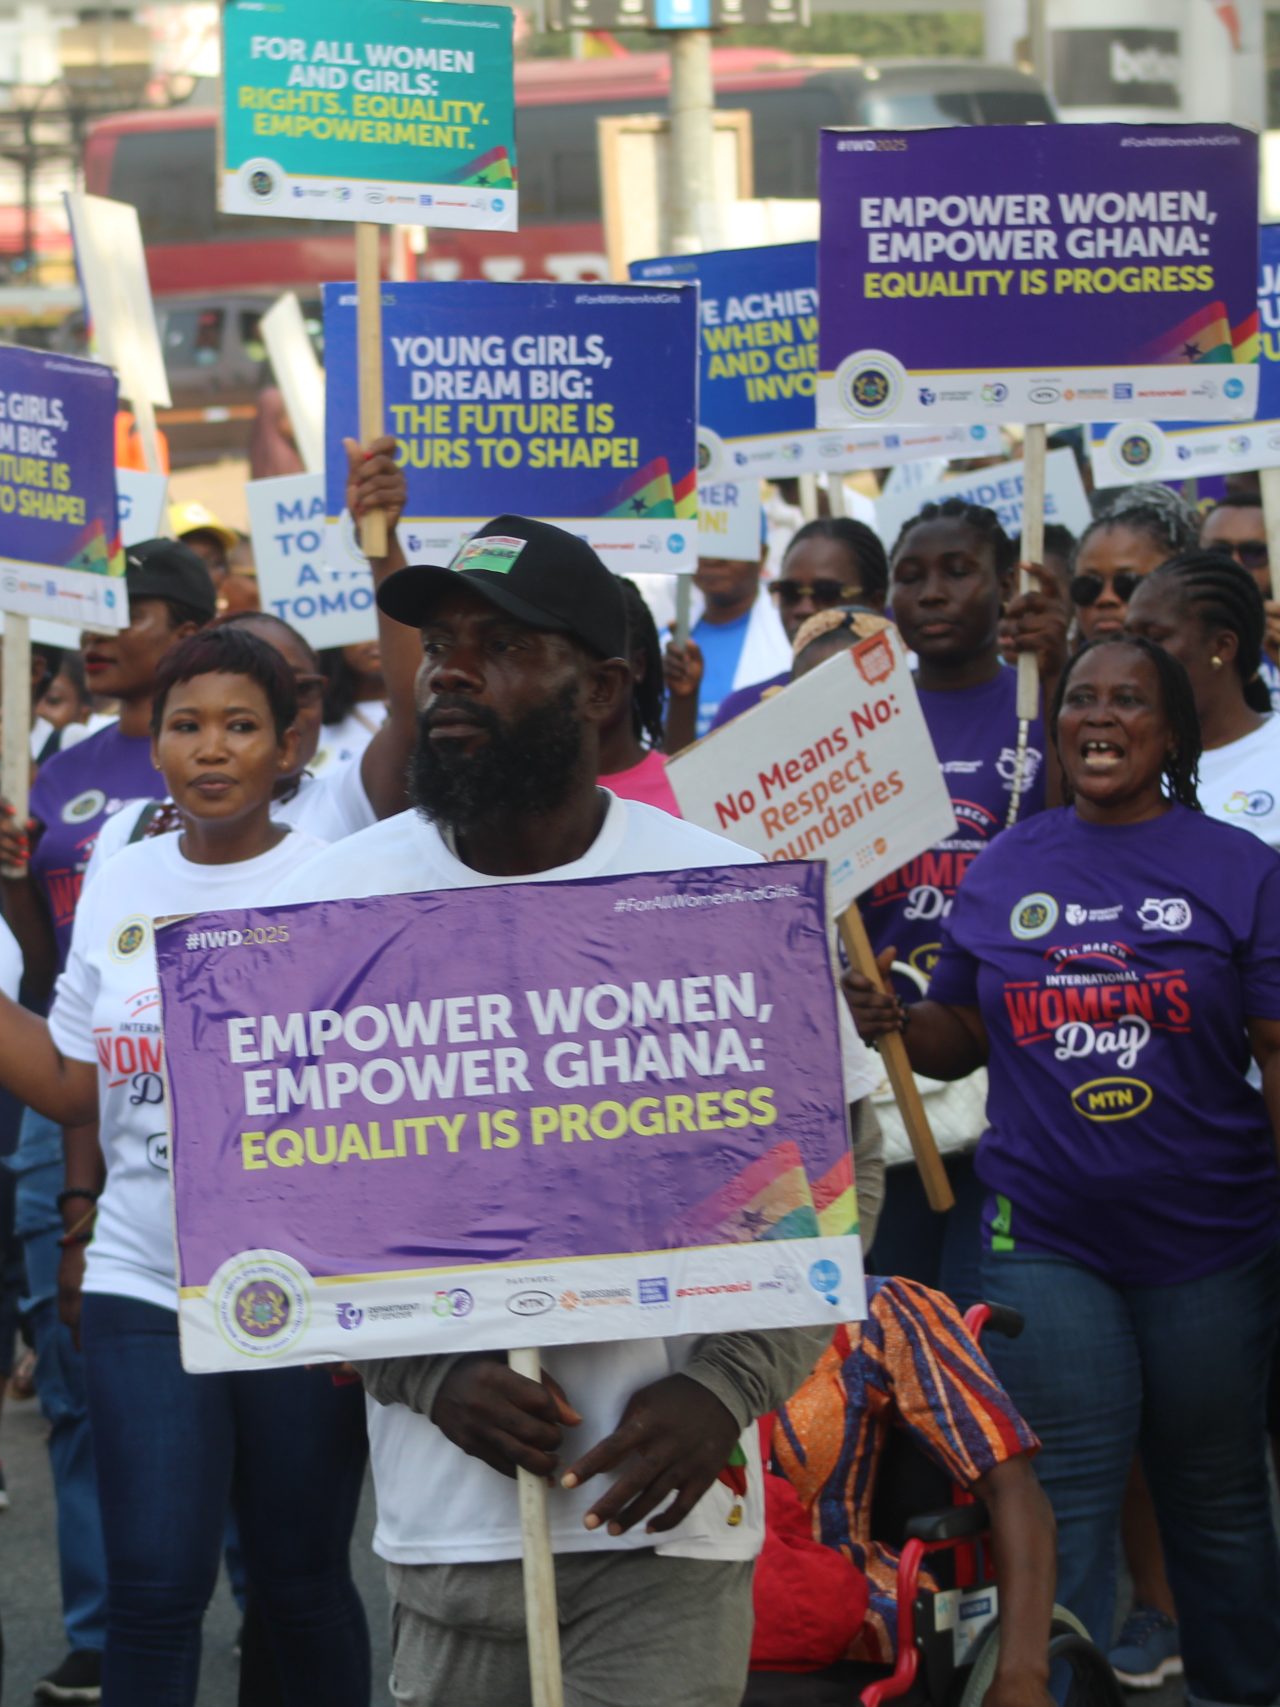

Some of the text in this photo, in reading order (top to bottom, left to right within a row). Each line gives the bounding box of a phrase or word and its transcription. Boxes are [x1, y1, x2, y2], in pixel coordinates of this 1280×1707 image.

[250, 36, 474, 74] FOR ALL WOMEN
[287, 65, 439, 96] AND GIRLS:
[238, 86, 489, 125] RIGHTS. EQUALITY.
[253, 113, 475, 149] EMPOWERMENT.
[860, 191, 1218, 229] EMPOWER WOMEN,
[868, 229, 1210, 264] EMPOWER GHANA:
[864, 264, 1215, 298] EQUALITY IS PROGRESS
[391, 336, 613, 369] YOUNG GIRLS,
[703, 318, 793, 352] WHEN
[708, 350, 770, 380] AND
[411, 370, 594, 400] DREAM BIG:
[8, 393, 68, 432] GIRLS,
[391, 404, 615, 434] THE FUTURE IS
[18, 427, 58, 458] BIG:
[394, 438, 639, 469] OURS TO SHAPE!
[52, 465, 70, 491] IS
[18, 490, 86, 525] SHAPE!
[714, 694, 902, 828] No Means No:
[760, 749, 872, 839] Respect
[770, 769, 905, 861] oundaries
[614, 884, 799, 912] #ForAllWomenAndGirls
[185, 925, 290, 951] #IWD2025
[1045, 971, 1139, 986] INTERNATIONAL
[226, 972, 775, 1064] EMPOWER WOMEN,
[1004, 979, 1191, 1037] WOMEN'S
[1054, 1014, 1151, 1069] Day
[243, 1028, 768, 1116] EMPOWER GHANA:
[1088, 1089, 1133, 1109] MTN
[240, 1087, 778, 1172] EQUALITY IS PROGRESS
